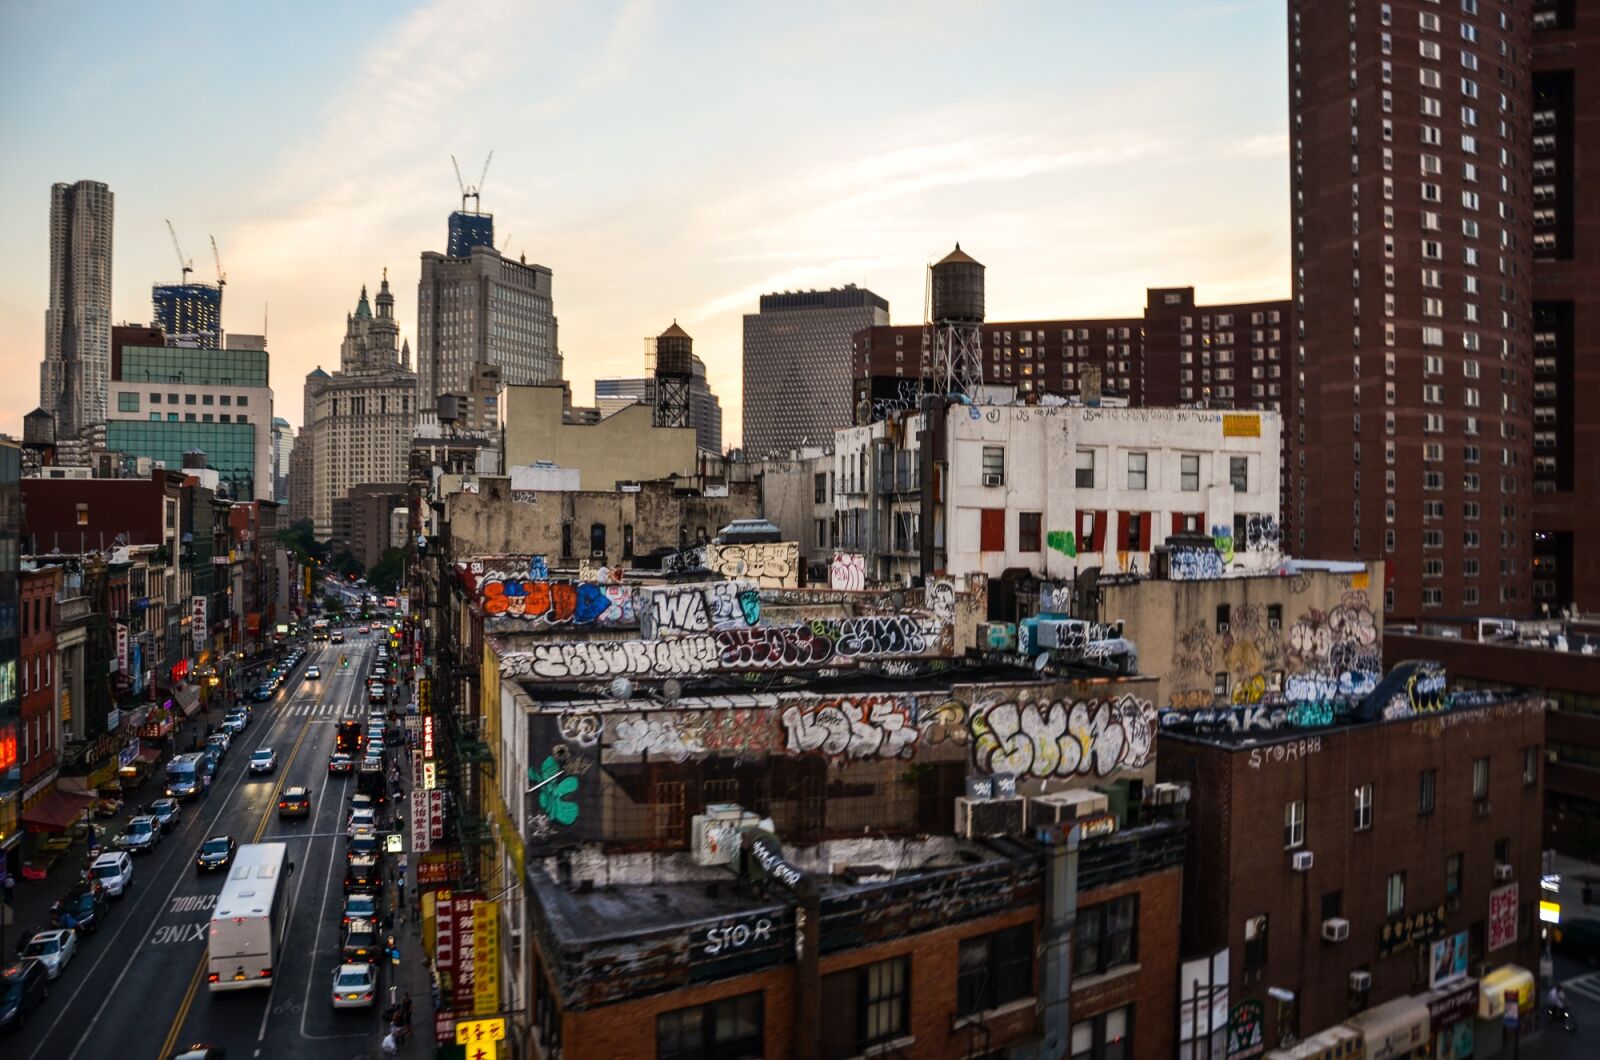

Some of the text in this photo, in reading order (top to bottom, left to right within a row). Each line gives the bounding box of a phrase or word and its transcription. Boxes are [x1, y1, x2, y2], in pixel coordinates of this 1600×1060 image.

[170, 894, 221, 913] CHOOL
[151, 922, 211, 945] XING
[703, 918, 773, 956] STOR
